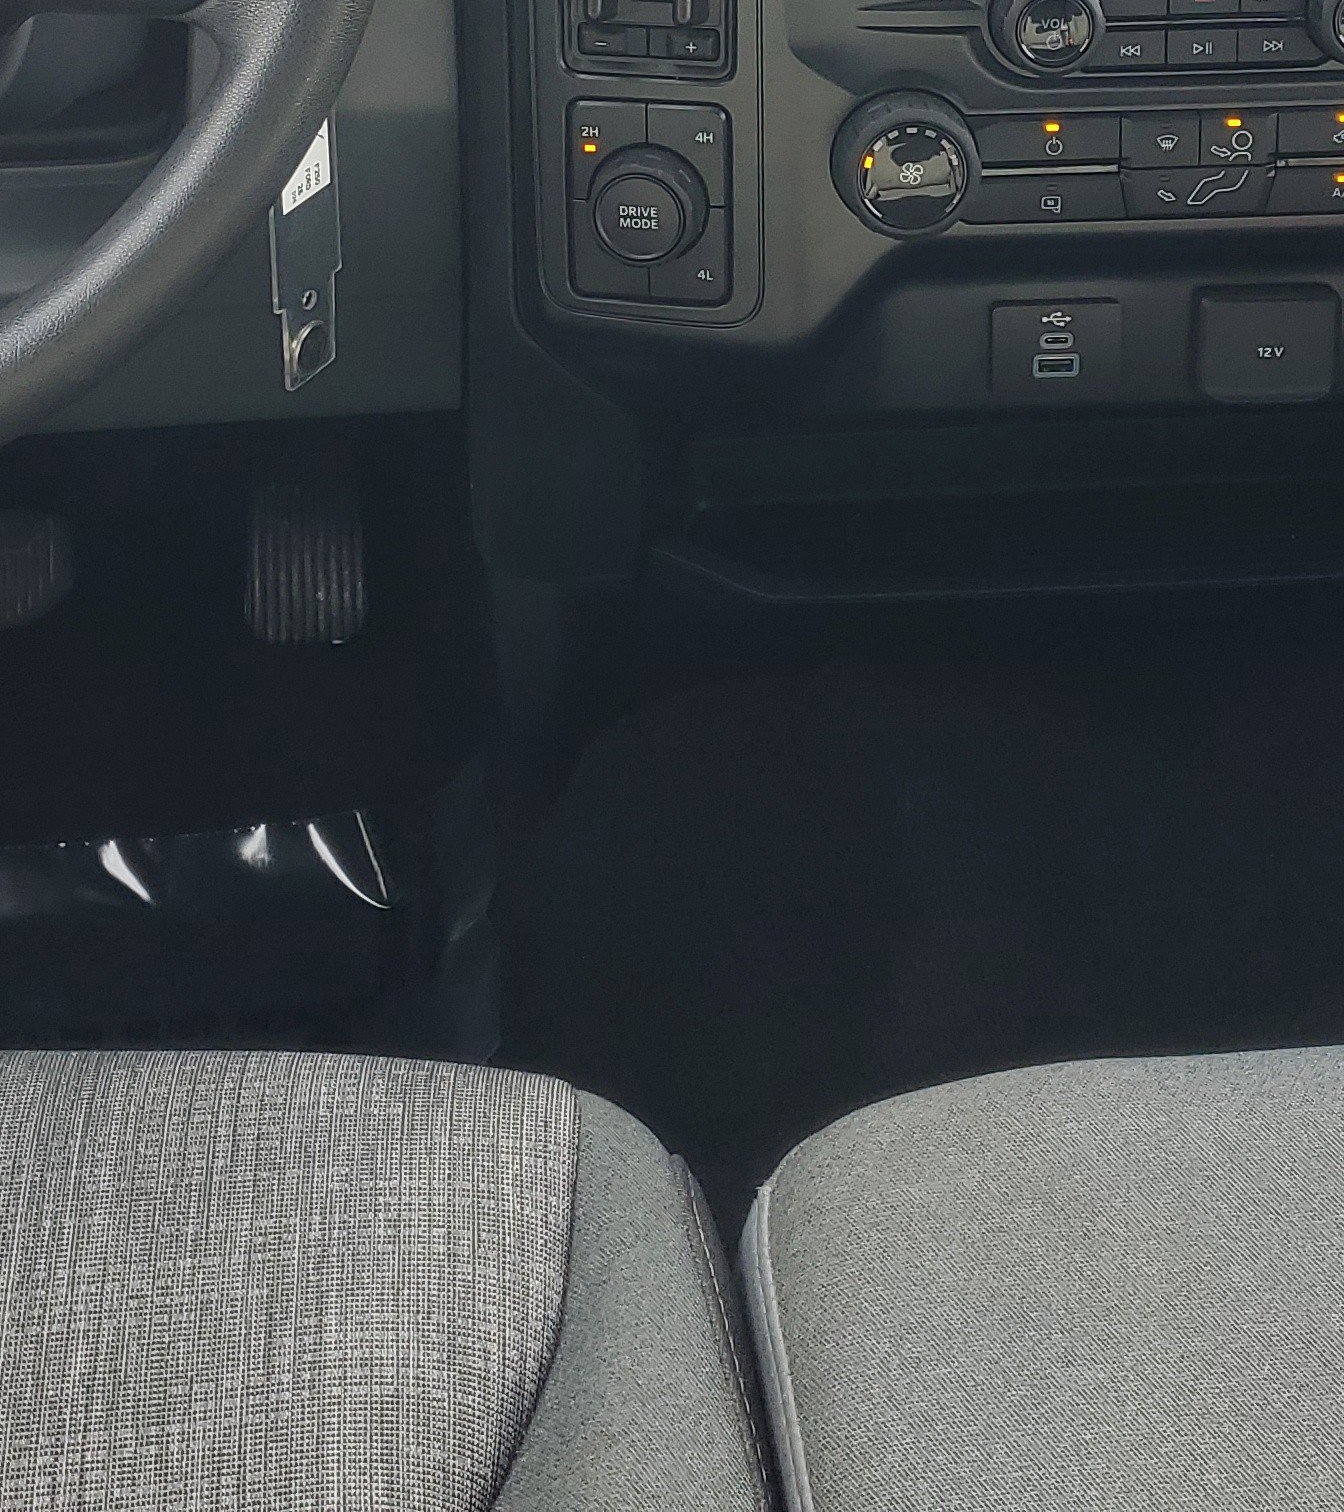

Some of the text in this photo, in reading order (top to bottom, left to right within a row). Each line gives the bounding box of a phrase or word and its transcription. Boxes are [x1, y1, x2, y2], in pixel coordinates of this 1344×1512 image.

[1041, 18, 1068, 30] VOL
[581, 126, 599, 138] 2H
[695, 132, 713, 144] 4H
[619, 206, 658, 218] DRIVE
[619, 217, 659, 230] MODE
[697, 269, 714, 281] 4L
